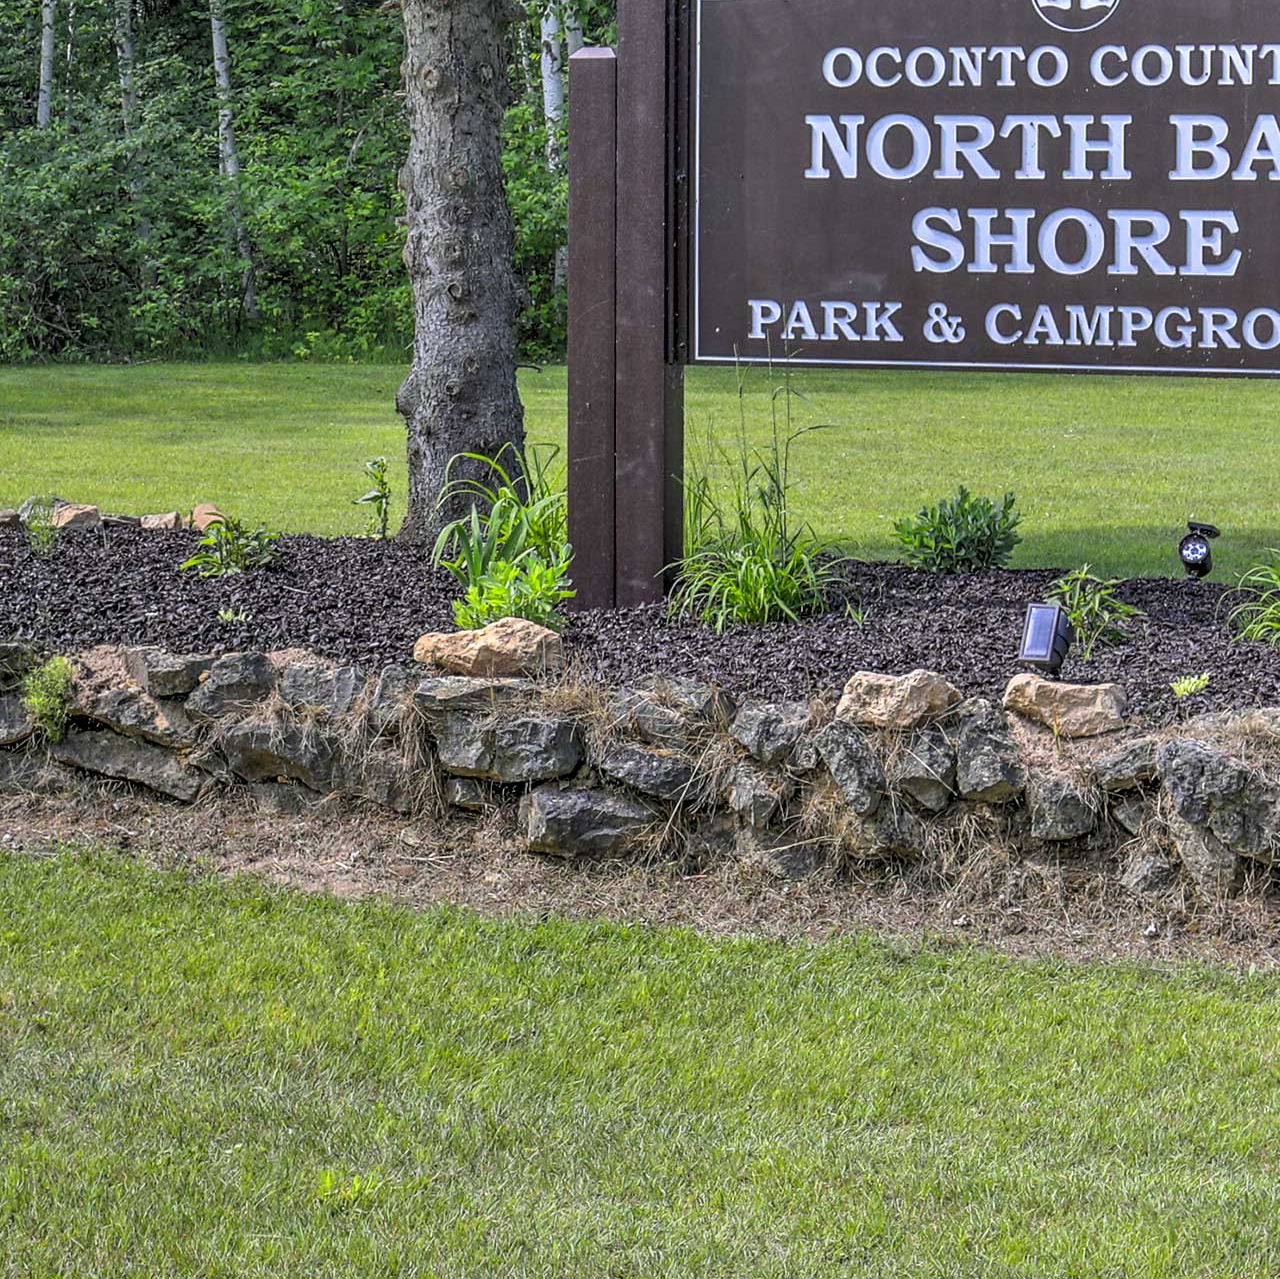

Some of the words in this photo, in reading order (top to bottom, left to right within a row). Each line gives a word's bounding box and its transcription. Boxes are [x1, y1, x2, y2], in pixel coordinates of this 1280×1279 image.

[821, 45, 1069, 87] OCONTO
[804, 113, 1132, 180] NORTH
[911, 207, 1242, 275] SHORE
[748, 299, 904, 343] PARK
[923, 302, 966, 344] &
